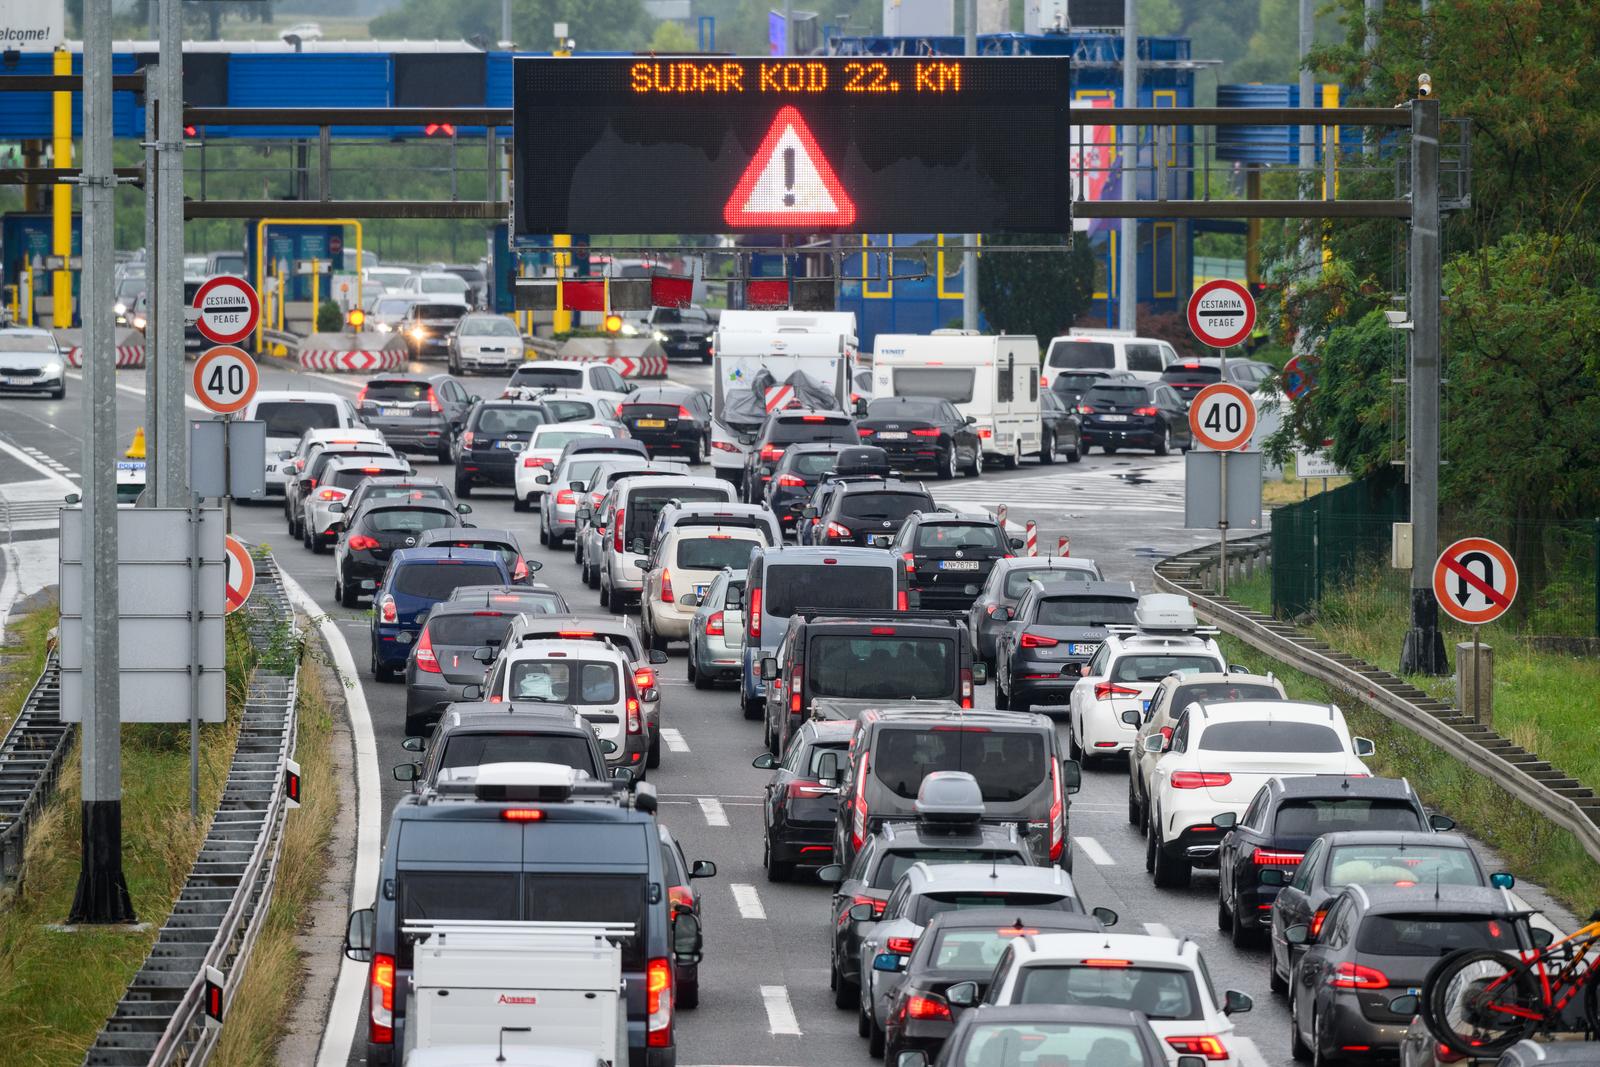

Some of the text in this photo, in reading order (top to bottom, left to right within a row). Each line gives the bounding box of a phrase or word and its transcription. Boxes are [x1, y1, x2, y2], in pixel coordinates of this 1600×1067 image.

[632, 63, 961, 93] SUDAR KOD 22. KM
[206, 297, 246, 305] CESTARINA
[1201, 300, 1242, 309] CESTARINA
[213, 315, 240, 323] PEAGE
[1208, 318, 1235, 327] PEAGE
[208, 364, 243, 395] 40
[1204, 402, 1241, 433] 40
